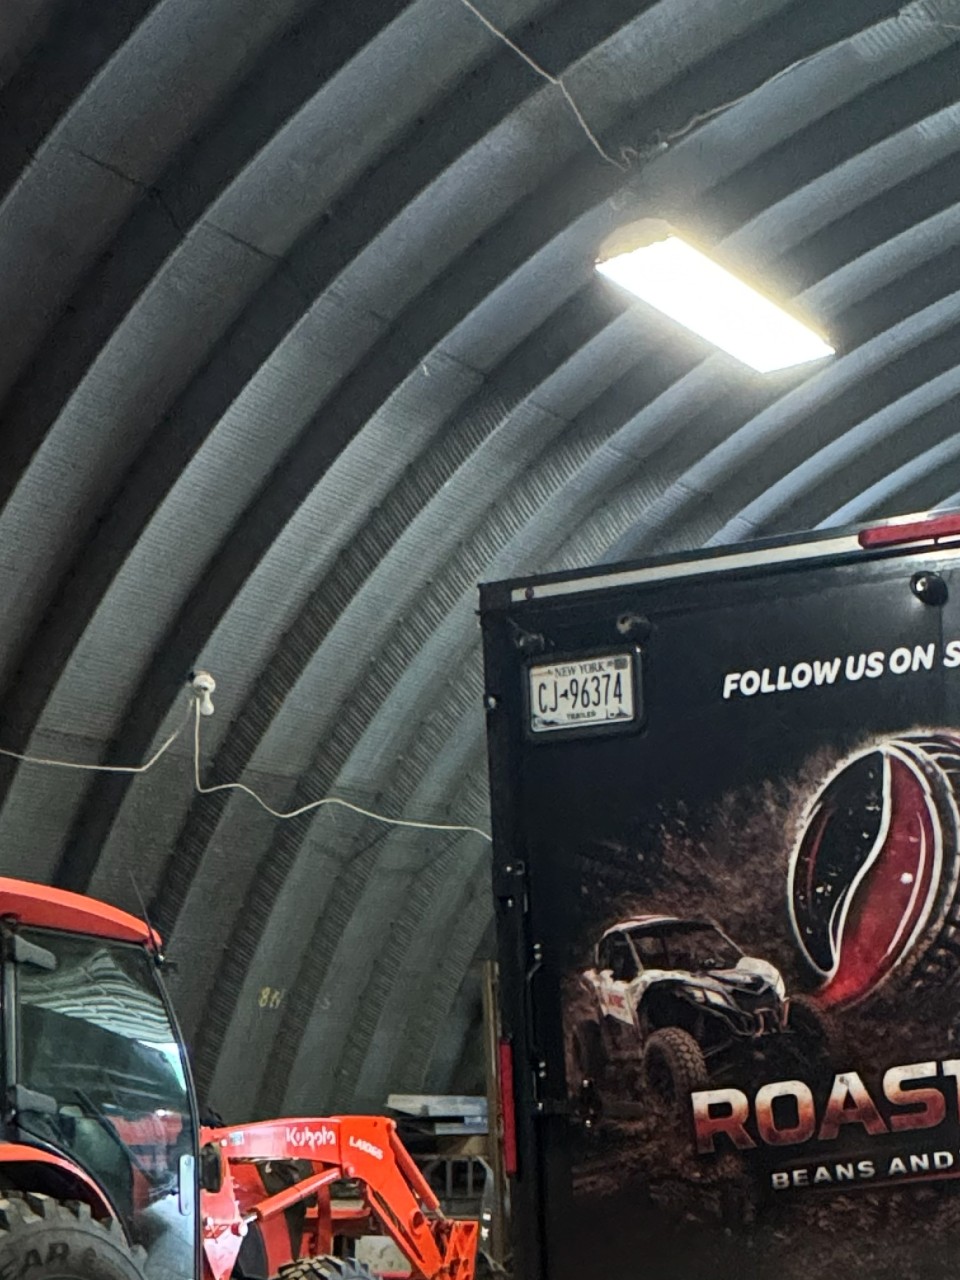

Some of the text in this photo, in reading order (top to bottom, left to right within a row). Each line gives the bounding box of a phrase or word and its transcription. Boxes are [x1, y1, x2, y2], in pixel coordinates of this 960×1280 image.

[554, 662, 605, 678] NEW YORK
[723, 658, 840, 699] FOLLOW
[844, 651, 884, 681] US
[894, 643, 935, 674] ON
[285, 1126, 337, 1151] Kubota
[771, 1160, 876, 1190] BEANS
[887, 1150, 955, 1176] AND
